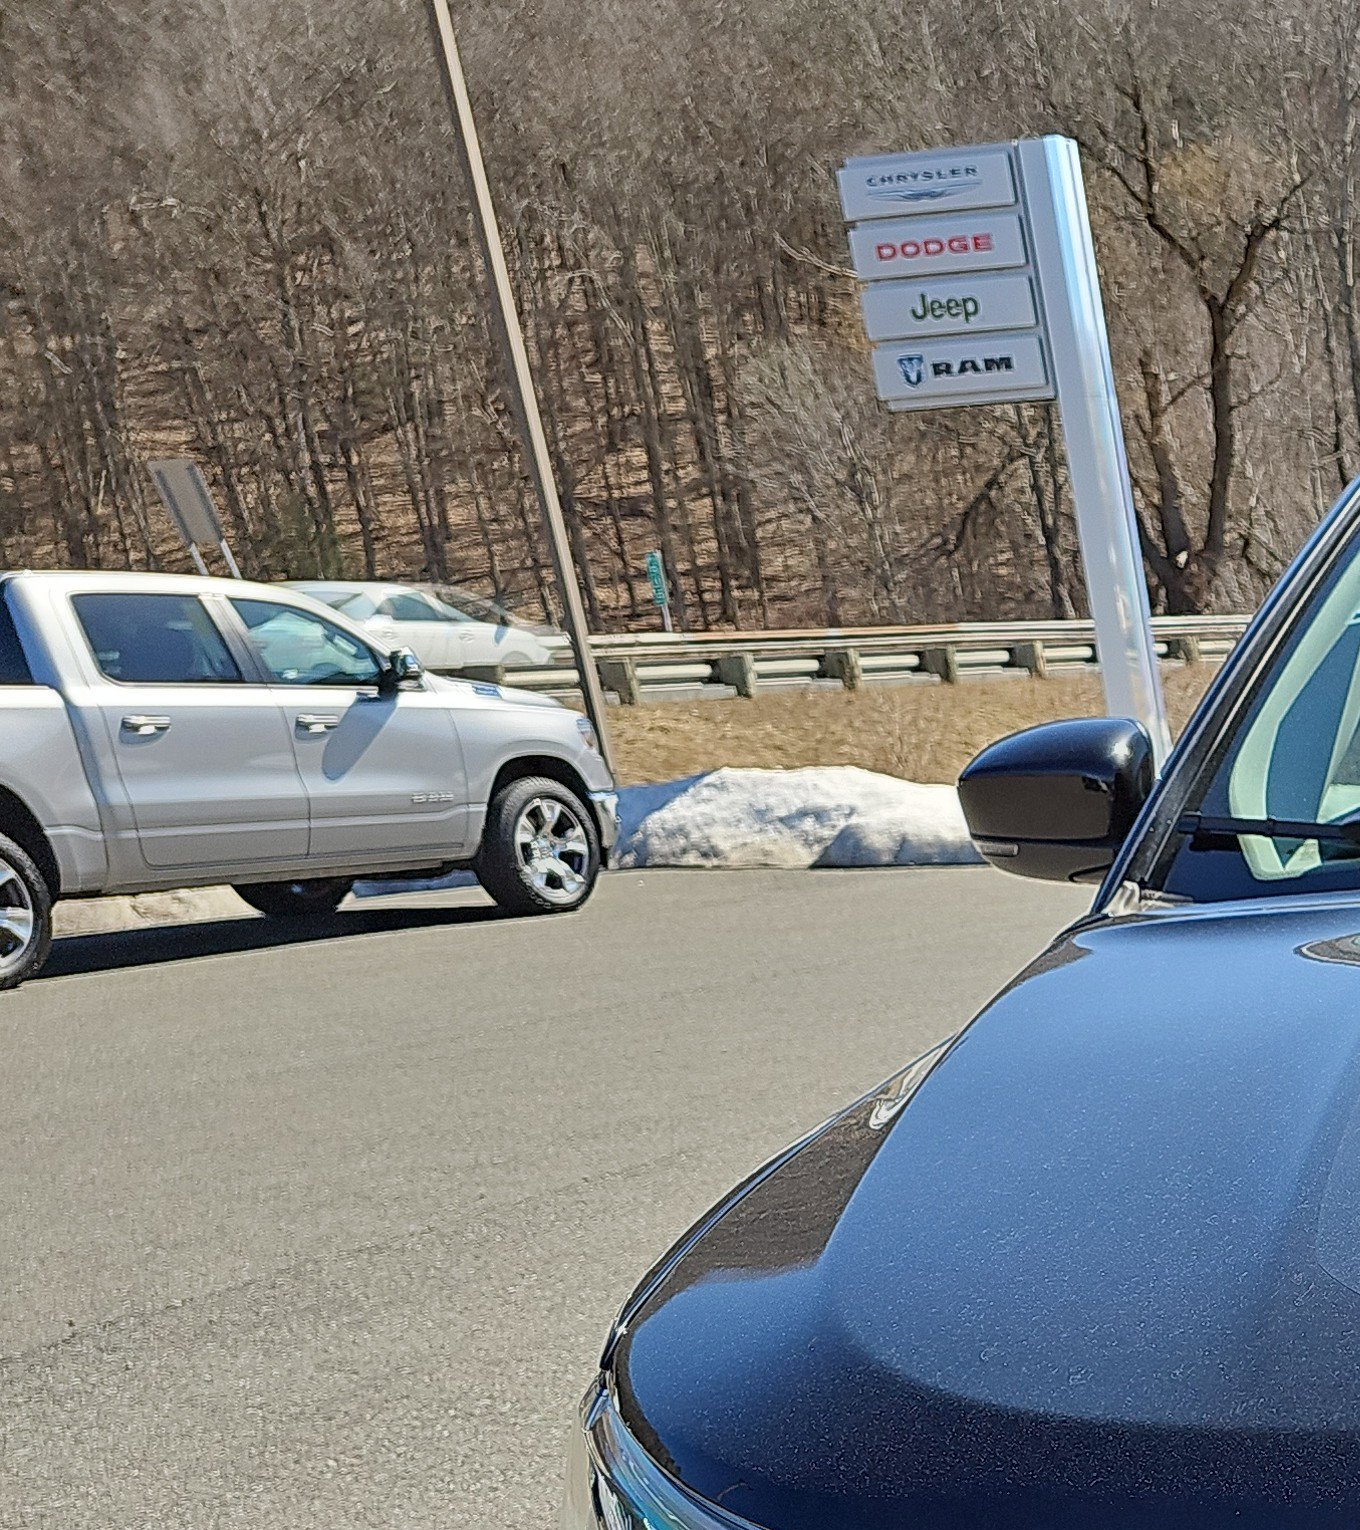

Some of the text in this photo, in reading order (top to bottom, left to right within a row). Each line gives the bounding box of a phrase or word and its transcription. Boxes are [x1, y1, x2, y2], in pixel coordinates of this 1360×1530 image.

[866, 165, 978, 187] CHRYSLER
[875, 233, 994, 262] DODGE
[911, 293, 979, 322] Jeep
[931, 356, 1013, 377] RAM
